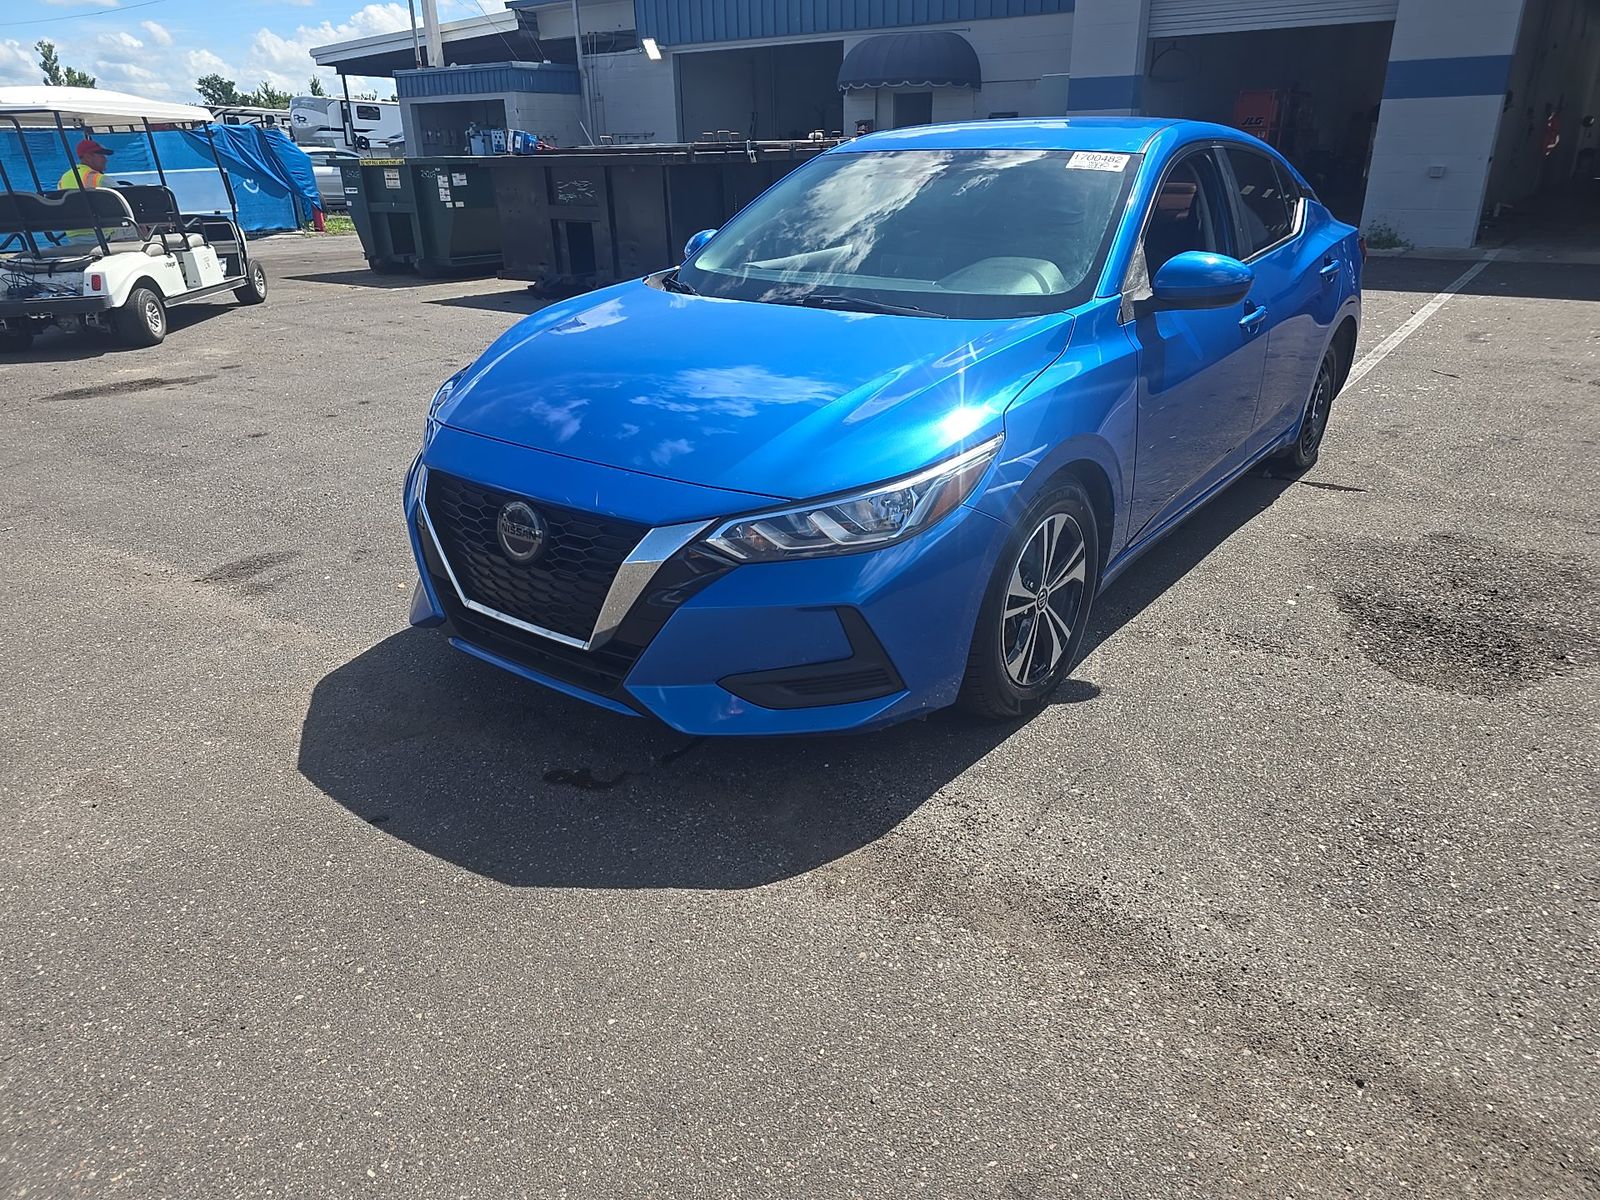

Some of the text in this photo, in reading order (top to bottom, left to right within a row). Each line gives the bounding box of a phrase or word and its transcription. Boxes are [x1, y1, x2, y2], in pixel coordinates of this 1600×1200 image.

[1241, 116, 1264, 126] JLG
[1074, 153, 1124, 163] 1700482
[502, 522, 537, 541] NISSAN
